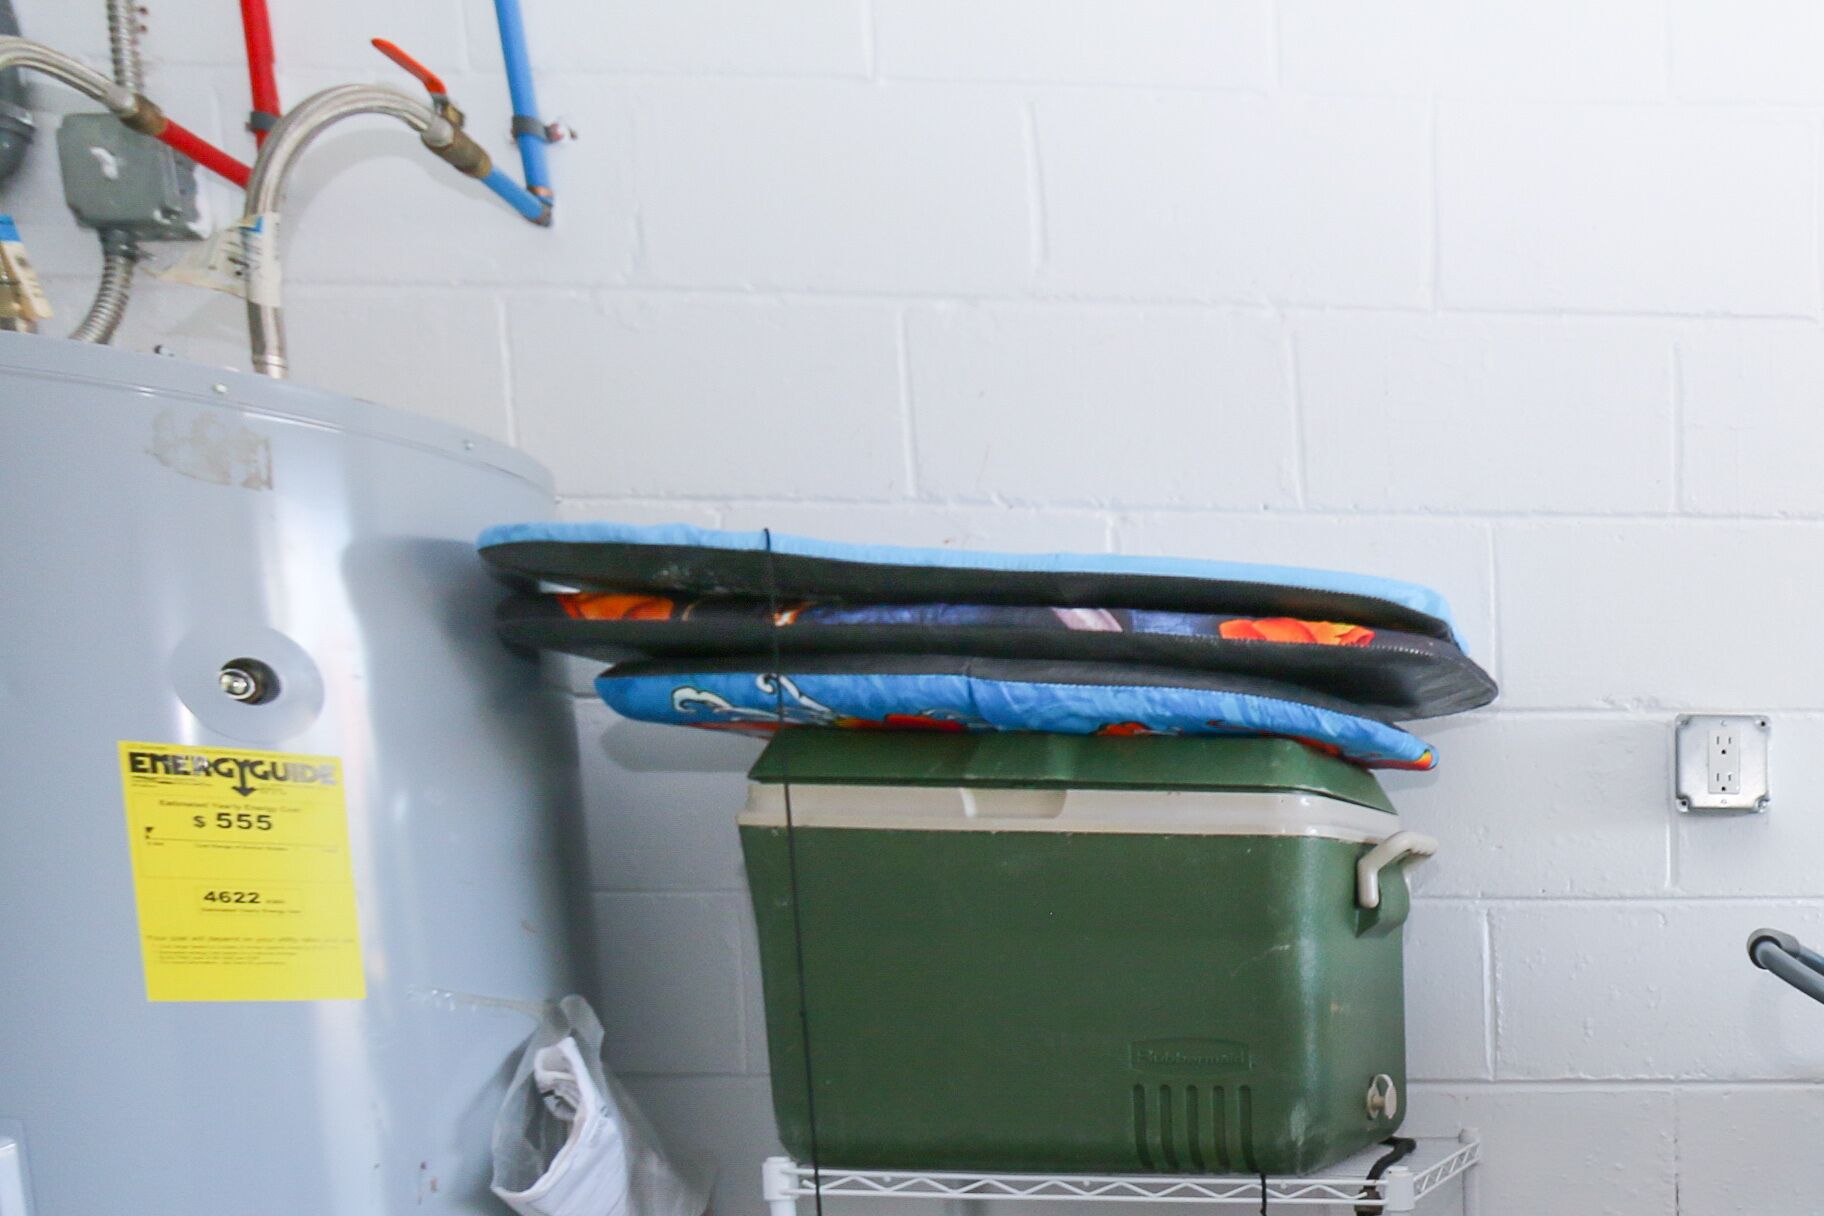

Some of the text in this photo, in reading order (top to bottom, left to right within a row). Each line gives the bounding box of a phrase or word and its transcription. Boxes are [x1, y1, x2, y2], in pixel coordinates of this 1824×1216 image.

[129, 751, 337, 787] ENERGYGUIDE
[193, 812, 273, 831] $ 555
[203, 890, 261, 904] 4622
